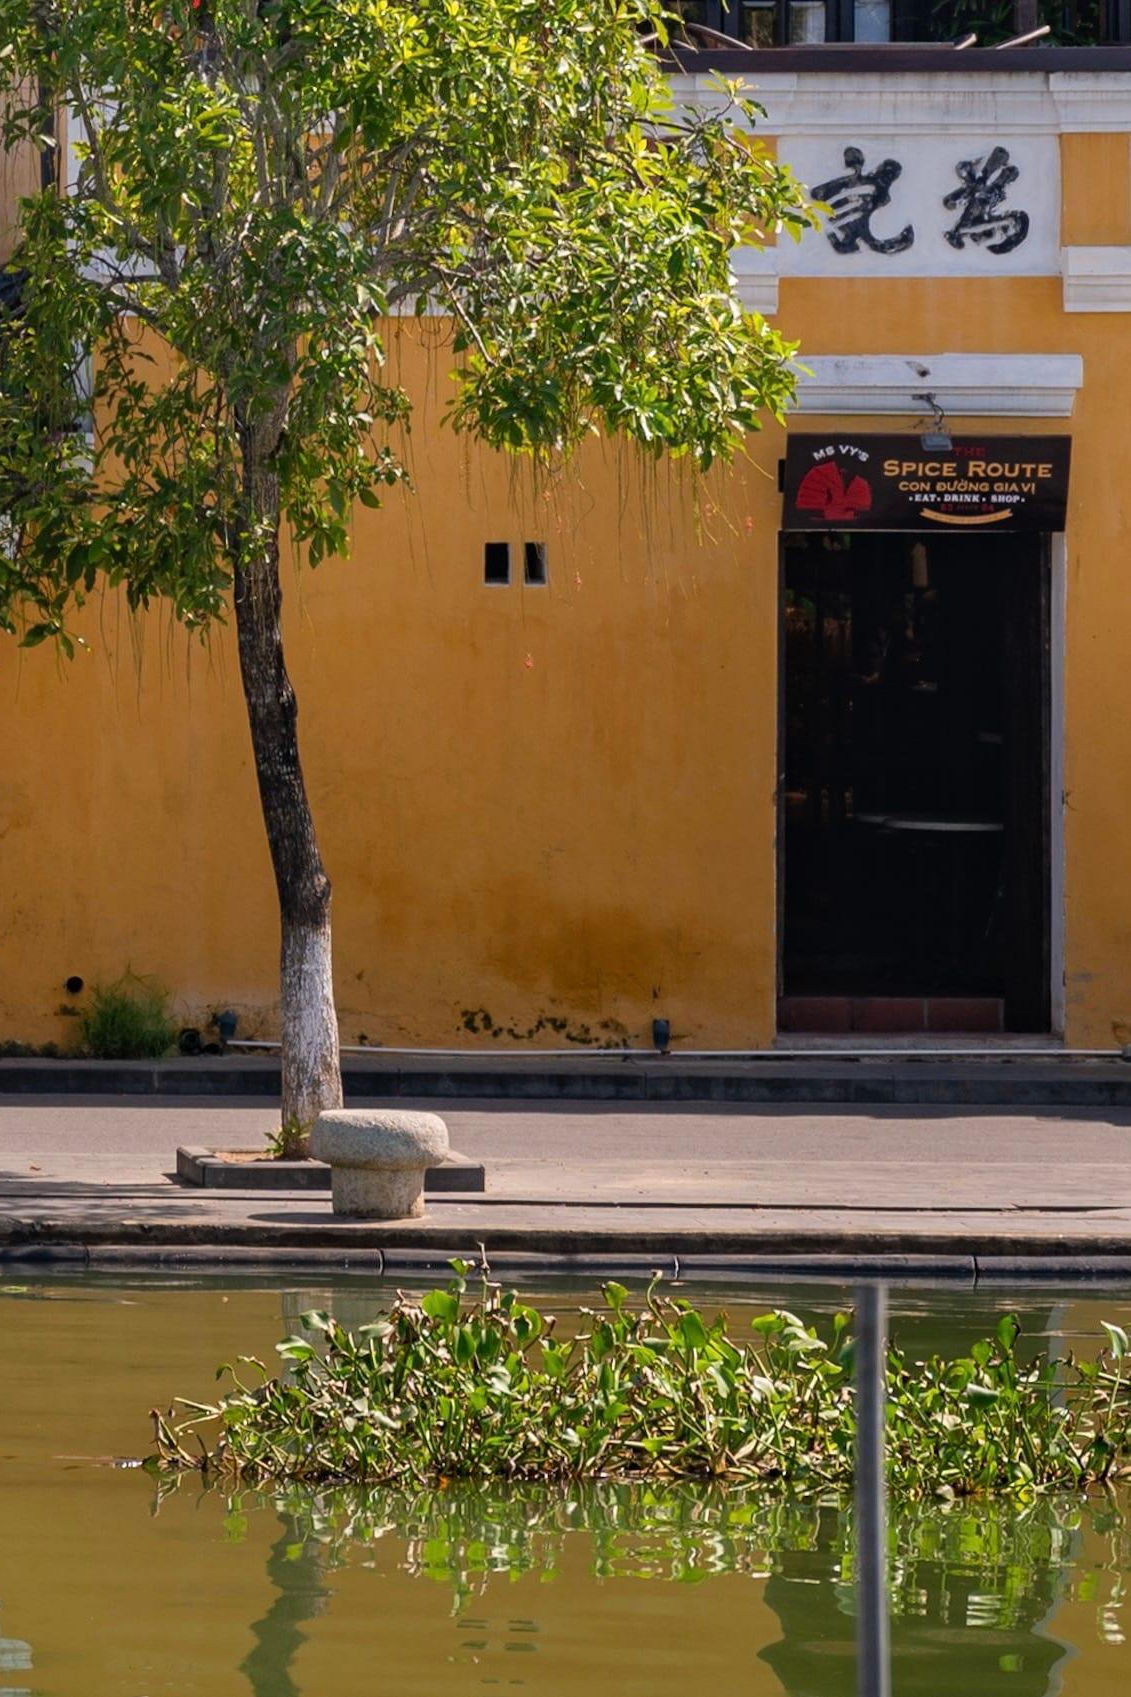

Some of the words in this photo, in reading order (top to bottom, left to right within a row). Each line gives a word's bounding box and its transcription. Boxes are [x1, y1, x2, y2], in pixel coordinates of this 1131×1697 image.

[813, 445, 836, 462] MS
[838, 444, 870, 463] VY'S
[953, 446, 986, 457] THE
[898, 481, 931, 492] CON
[993, 481, 1019, 492] GIA
[914, 493, 937, 503] EAT
[943, 493, 980, 503] DRINK
[990, 494, 1021, 504] SHOP
